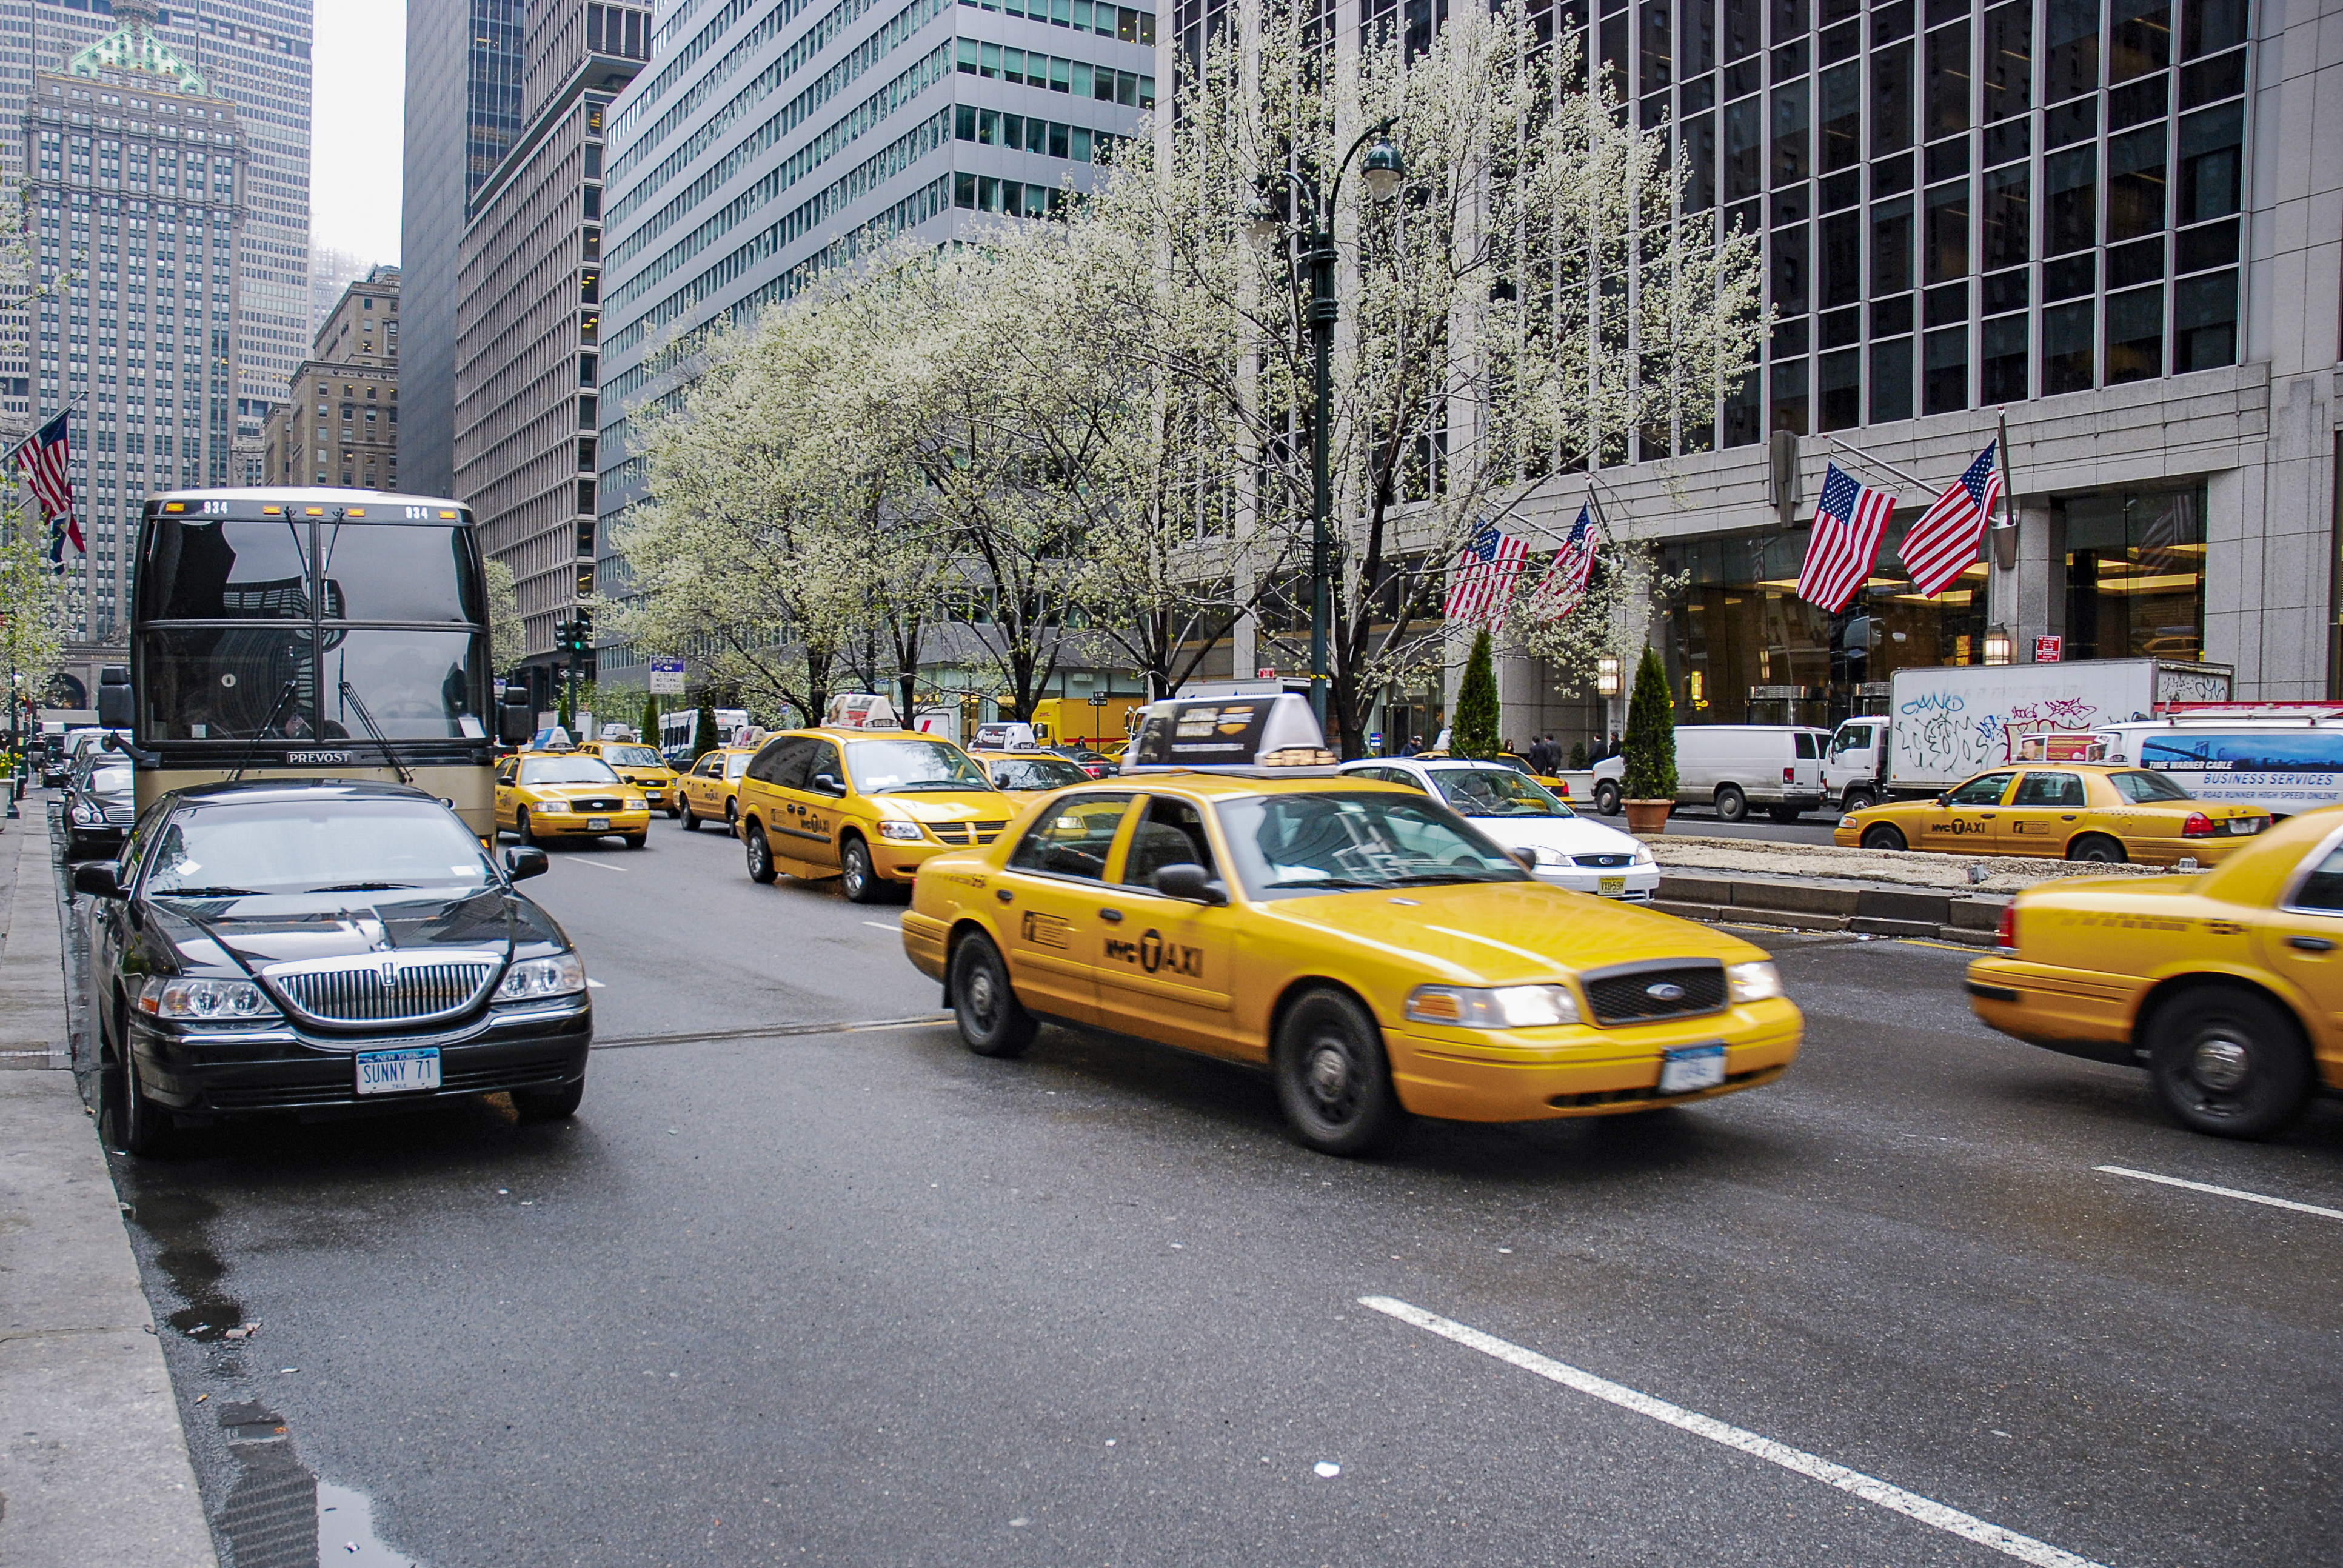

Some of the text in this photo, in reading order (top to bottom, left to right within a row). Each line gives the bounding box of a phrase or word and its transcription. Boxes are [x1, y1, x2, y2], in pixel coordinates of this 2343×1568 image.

[204, 501, 228, 514] 934
[406, 506, 428, 519] 934
[289, 753, 350, 762] PREVOST
[2204, 773, 2334, 786] BUSINESS SERVICES
[1932, 818, 1985, 835] NYC TAXI
[377, 1052, 419, 1062] NEW YORK
[364, 1059, 430, 1084] SUNNY 71
